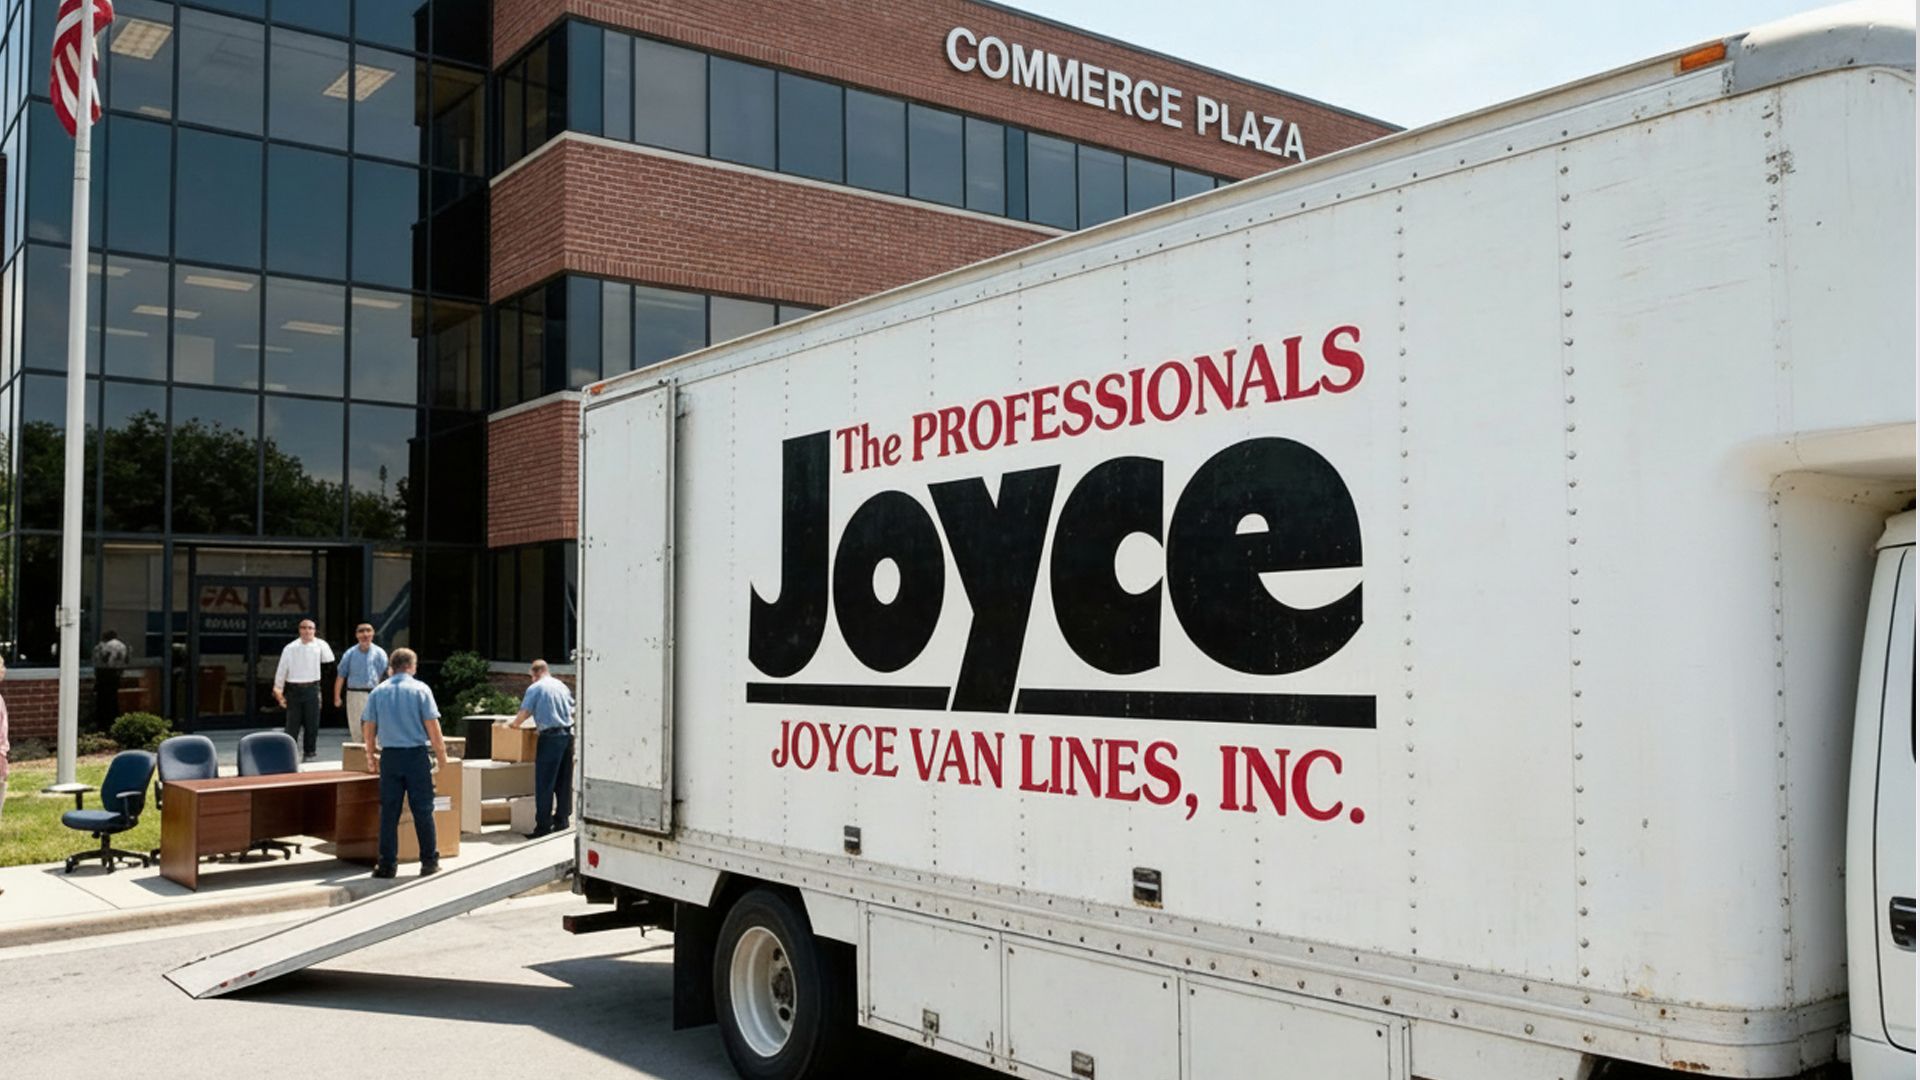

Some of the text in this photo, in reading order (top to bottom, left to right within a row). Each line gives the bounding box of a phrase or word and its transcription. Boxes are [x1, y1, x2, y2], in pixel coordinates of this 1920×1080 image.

[945, 26, 1306, 162] COMMERCE PLAZA
[836, 325, 1365, 473] The PROFESSIONALS
[748, 430, 1364, 714] Joyce
[771, 719, 1365, 825] JOYCE VAN LINES, INC.
